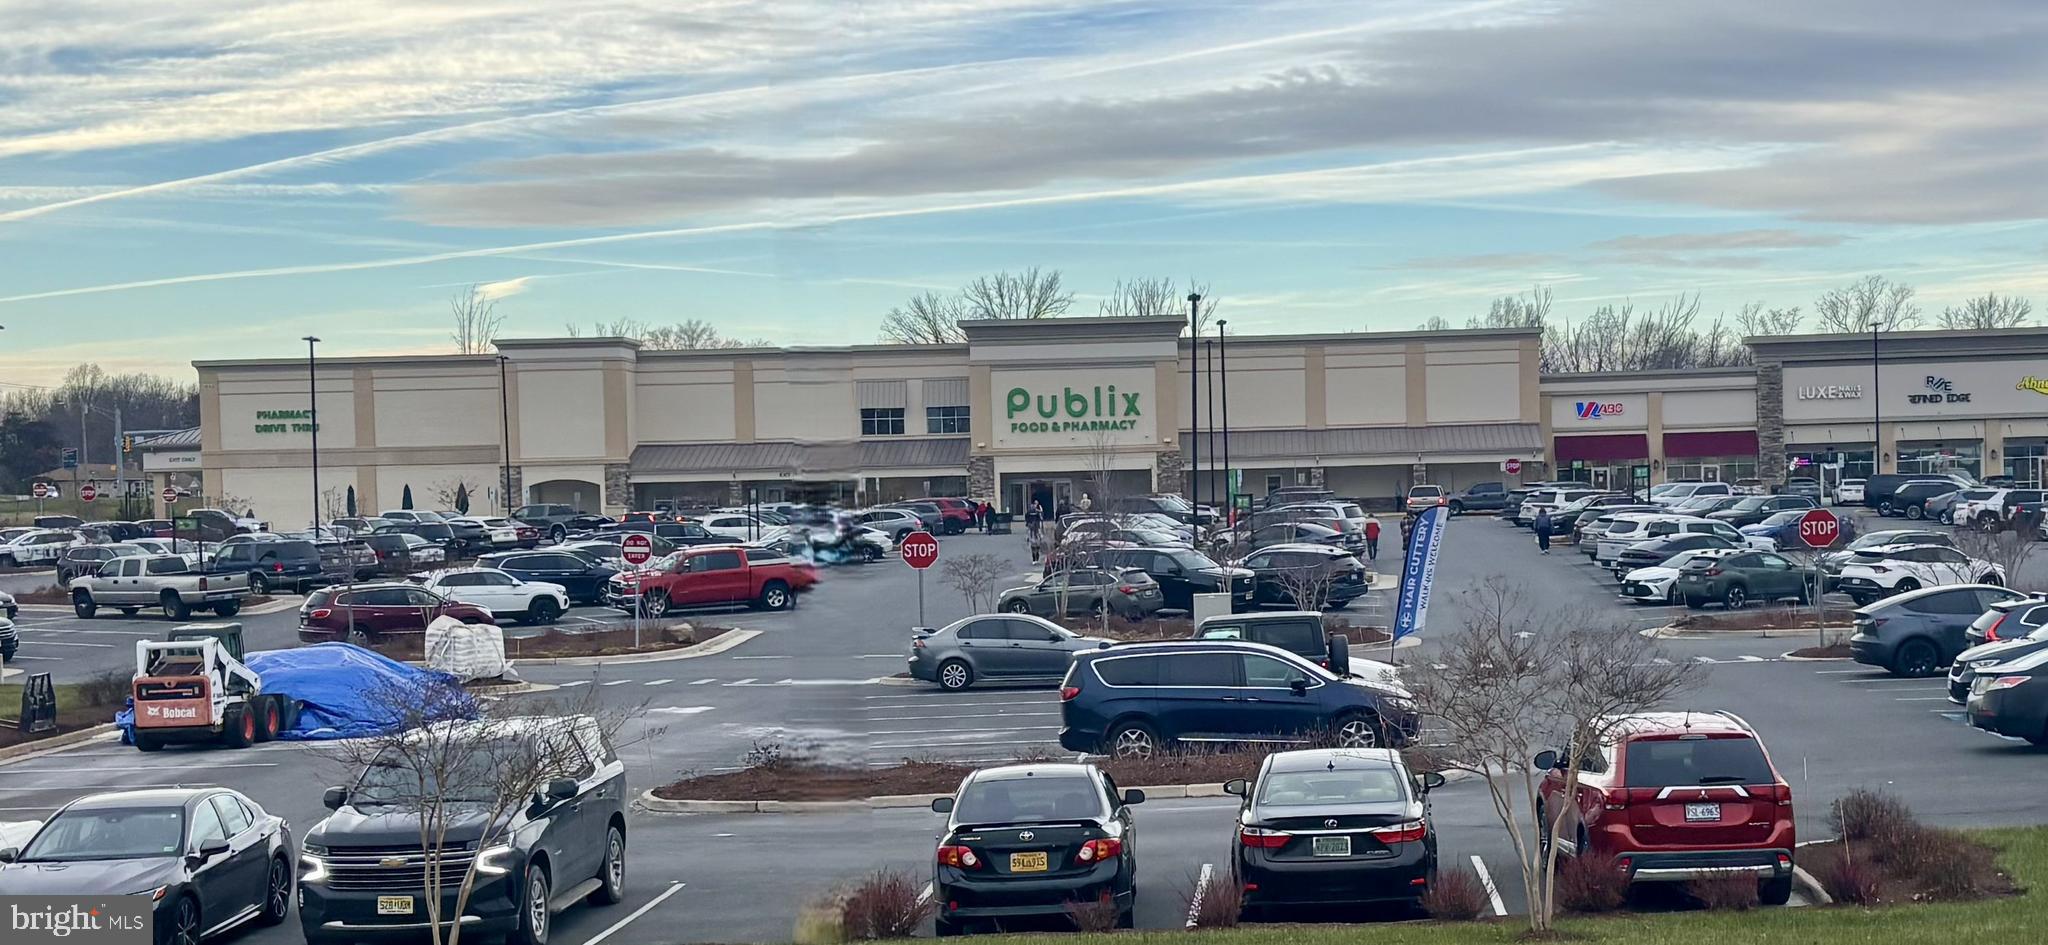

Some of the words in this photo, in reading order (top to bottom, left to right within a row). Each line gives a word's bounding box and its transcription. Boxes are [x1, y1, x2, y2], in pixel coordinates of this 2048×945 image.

[1799, 385, 1838, 400] LUXE
[1006, 385, 1142, 419] Publix
[256, 410, 316, 420] PHARMAC
[255, 424, 287, 434] DRIVE
[1011, 422, 1049, 433] FOOD
[1052, 421, 1061, 432] &
[1063, 419, 1137, 432] PHARMACY
[1802, 521, 1836, 536] STOP
[904, 543, 936, 558] STOP
[1409, 516, 1430, 576] CUTTERY
[1428, 522, 1445, 567] WELCOME
[1404, 578, 1417, 609] HAIR
[163, 707, 197, 719] Bobcat
